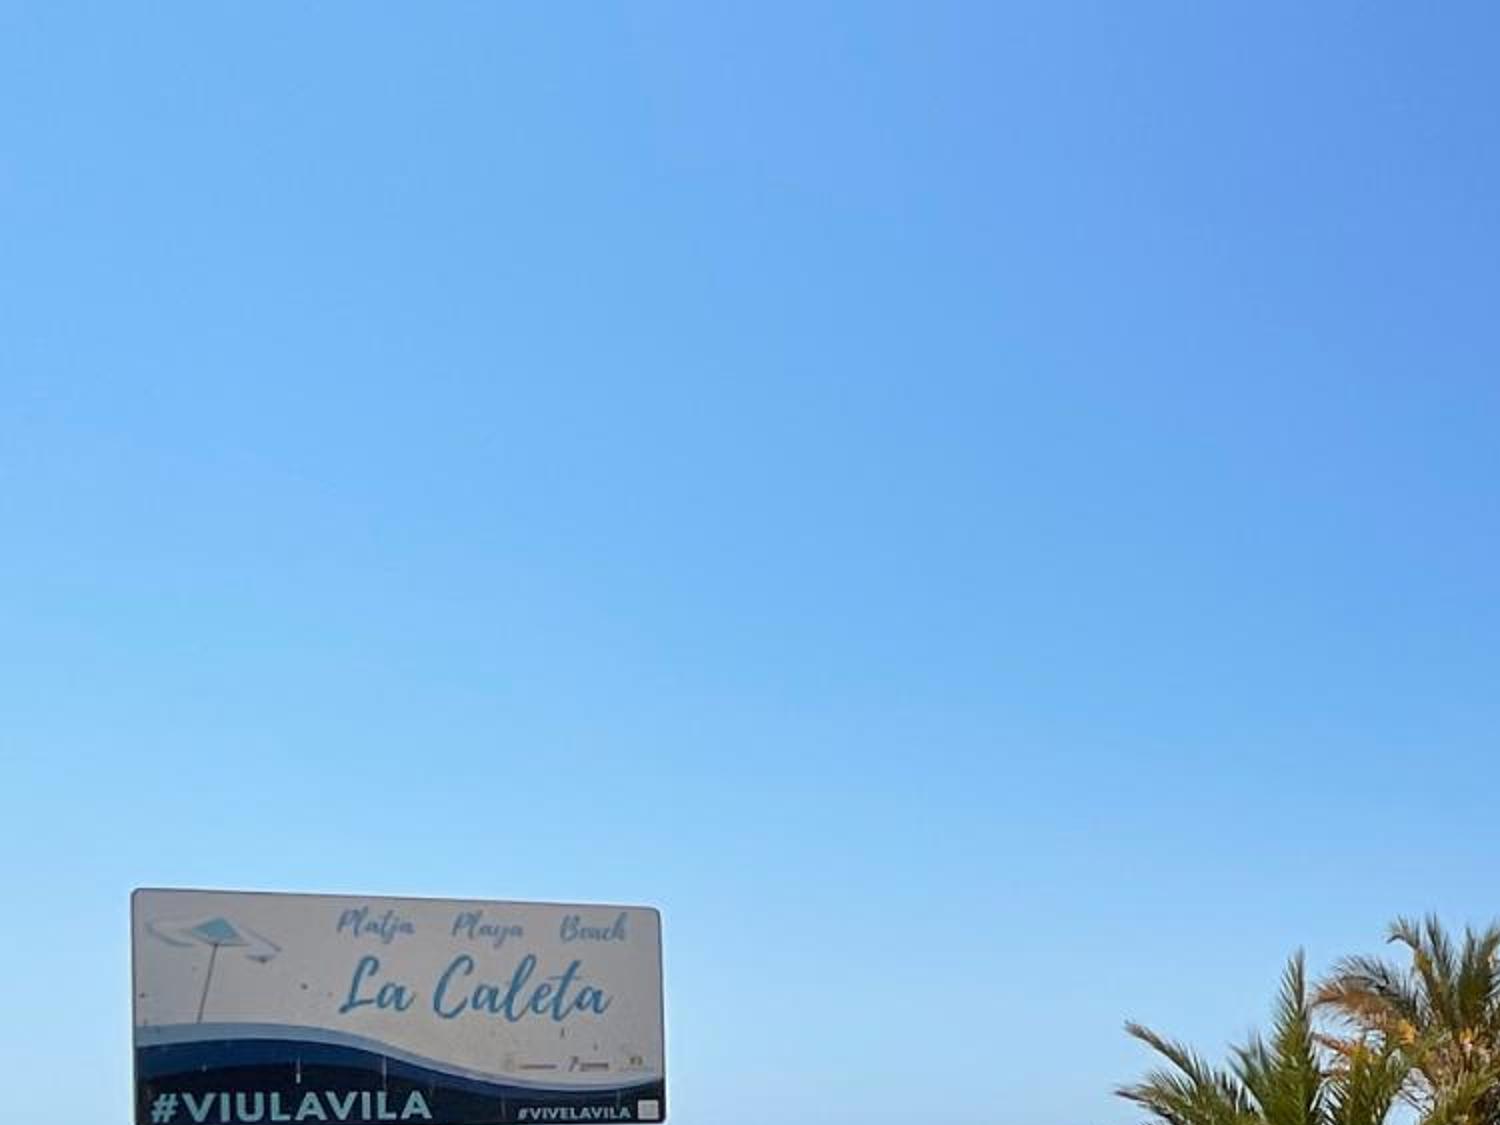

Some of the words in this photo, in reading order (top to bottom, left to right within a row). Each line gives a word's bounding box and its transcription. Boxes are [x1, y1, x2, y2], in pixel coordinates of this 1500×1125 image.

[337, 906, 415, 944] Platja
[452, 909, 524, 949] Playa
[559, 912, 628, 942] Beach
[338, 955, 416, 1014] La
[433, 954, 611, 1022] Caleta
[151, 1090, 433, 1123] #VIULAVILA
[518, 1106, 632, 1121] #VIVELAVILA
